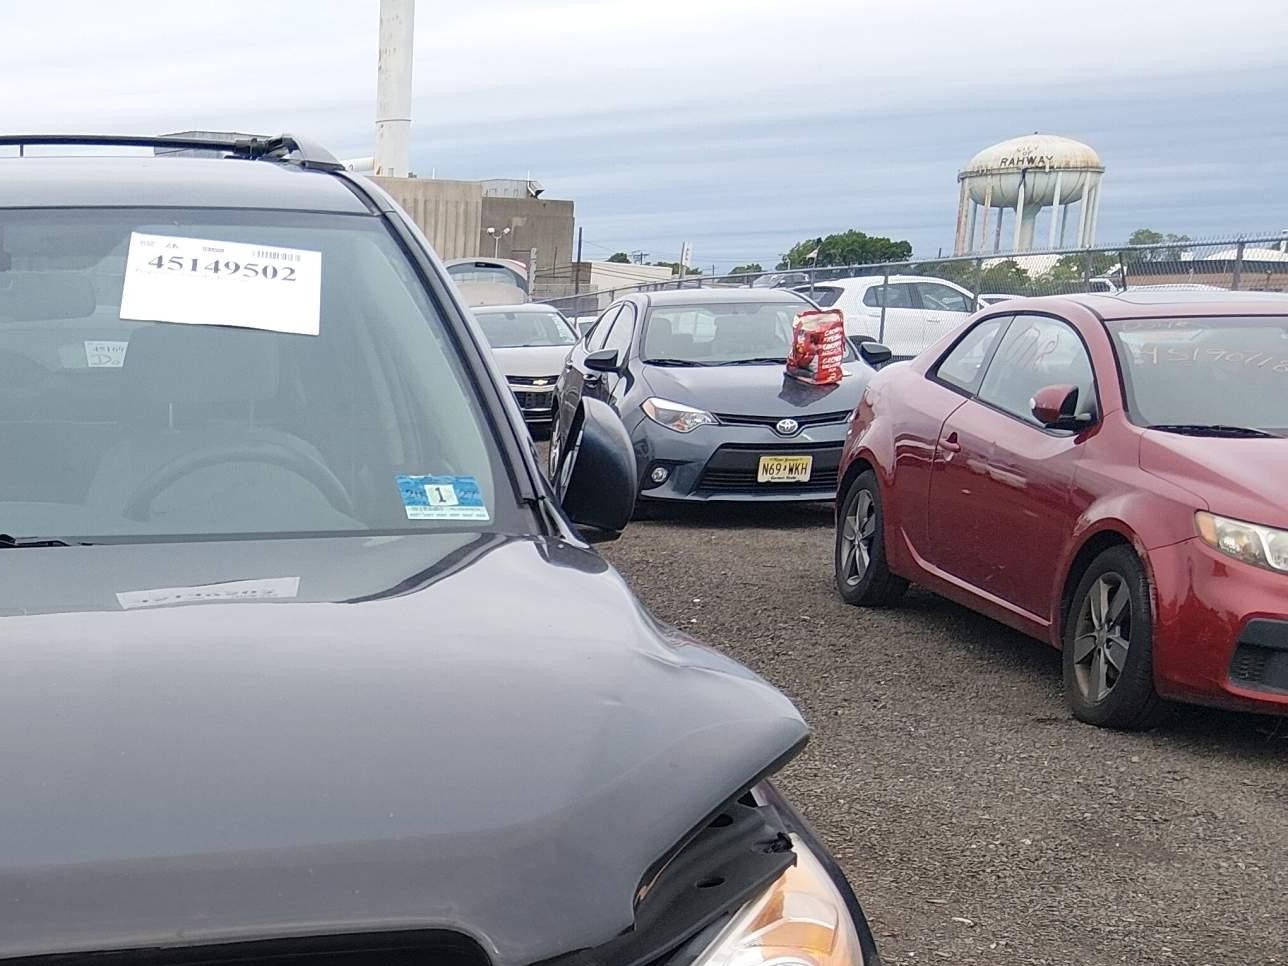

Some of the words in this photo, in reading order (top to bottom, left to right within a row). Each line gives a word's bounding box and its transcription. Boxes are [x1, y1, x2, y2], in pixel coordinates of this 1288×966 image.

[999, 155, 1054, 167] RAHWAY
[148, 255, 297, 282] 45149502
[434, 487, 447, 503] 1
